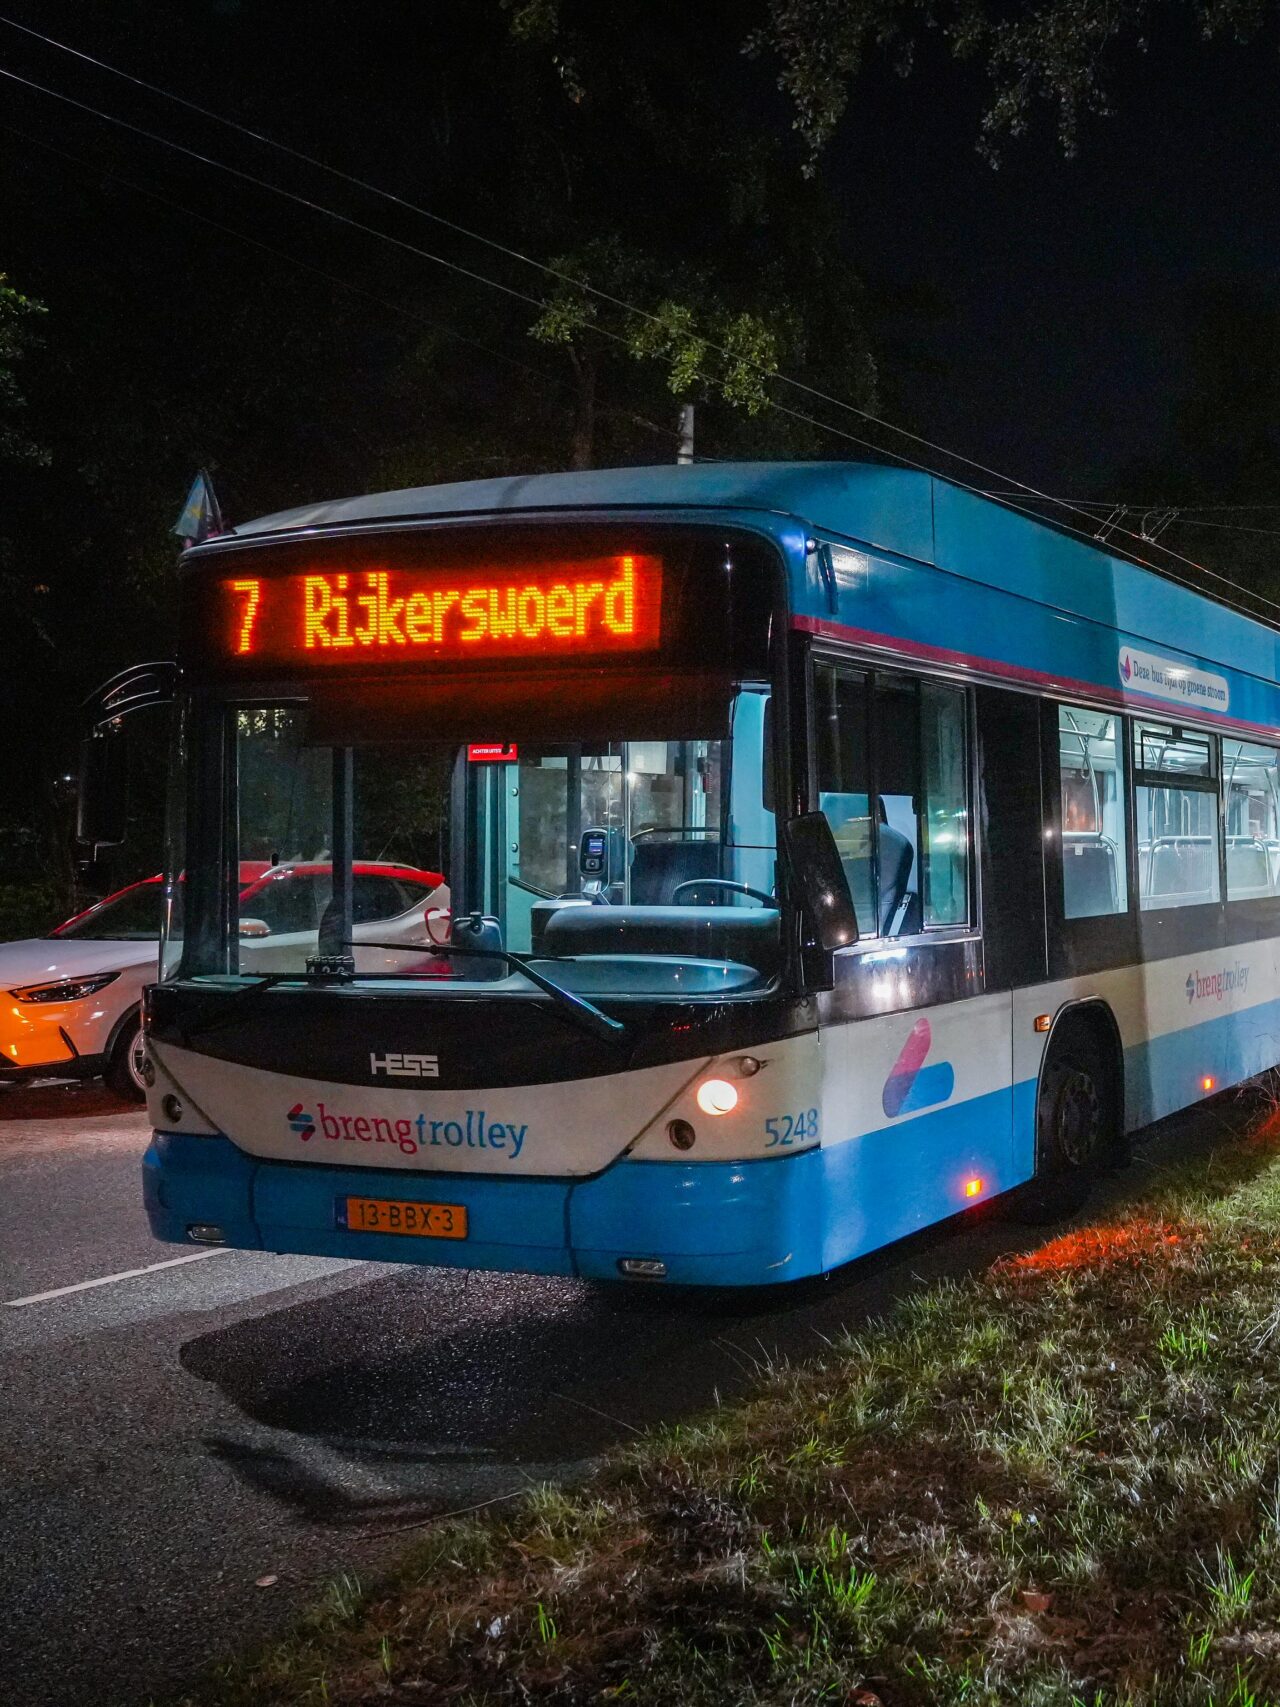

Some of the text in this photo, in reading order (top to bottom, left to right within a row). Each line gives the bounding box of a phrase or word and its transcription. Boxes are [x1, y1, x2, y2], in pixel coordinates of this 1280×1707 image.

[233, 556, 634, 652] 7 Rijkerswoerd
[1133, 660, 1150, 680] Deze
[1151, 665, 1163, 684] bus
[1178, 679, 1187, 694] op
[1187, 681, 1207, 696] groene
[1207, 685, 1226, 701] stroom
[1195, 961, 1249, 1000] brengtrolley
[370, 1052, 440, 1077] HESS
[317, 1103, 529, 1159] brengtrolley
[764, 1108, 818, 1148] 5248
[359, 1203, 454, 1232] 13-BBX-3
